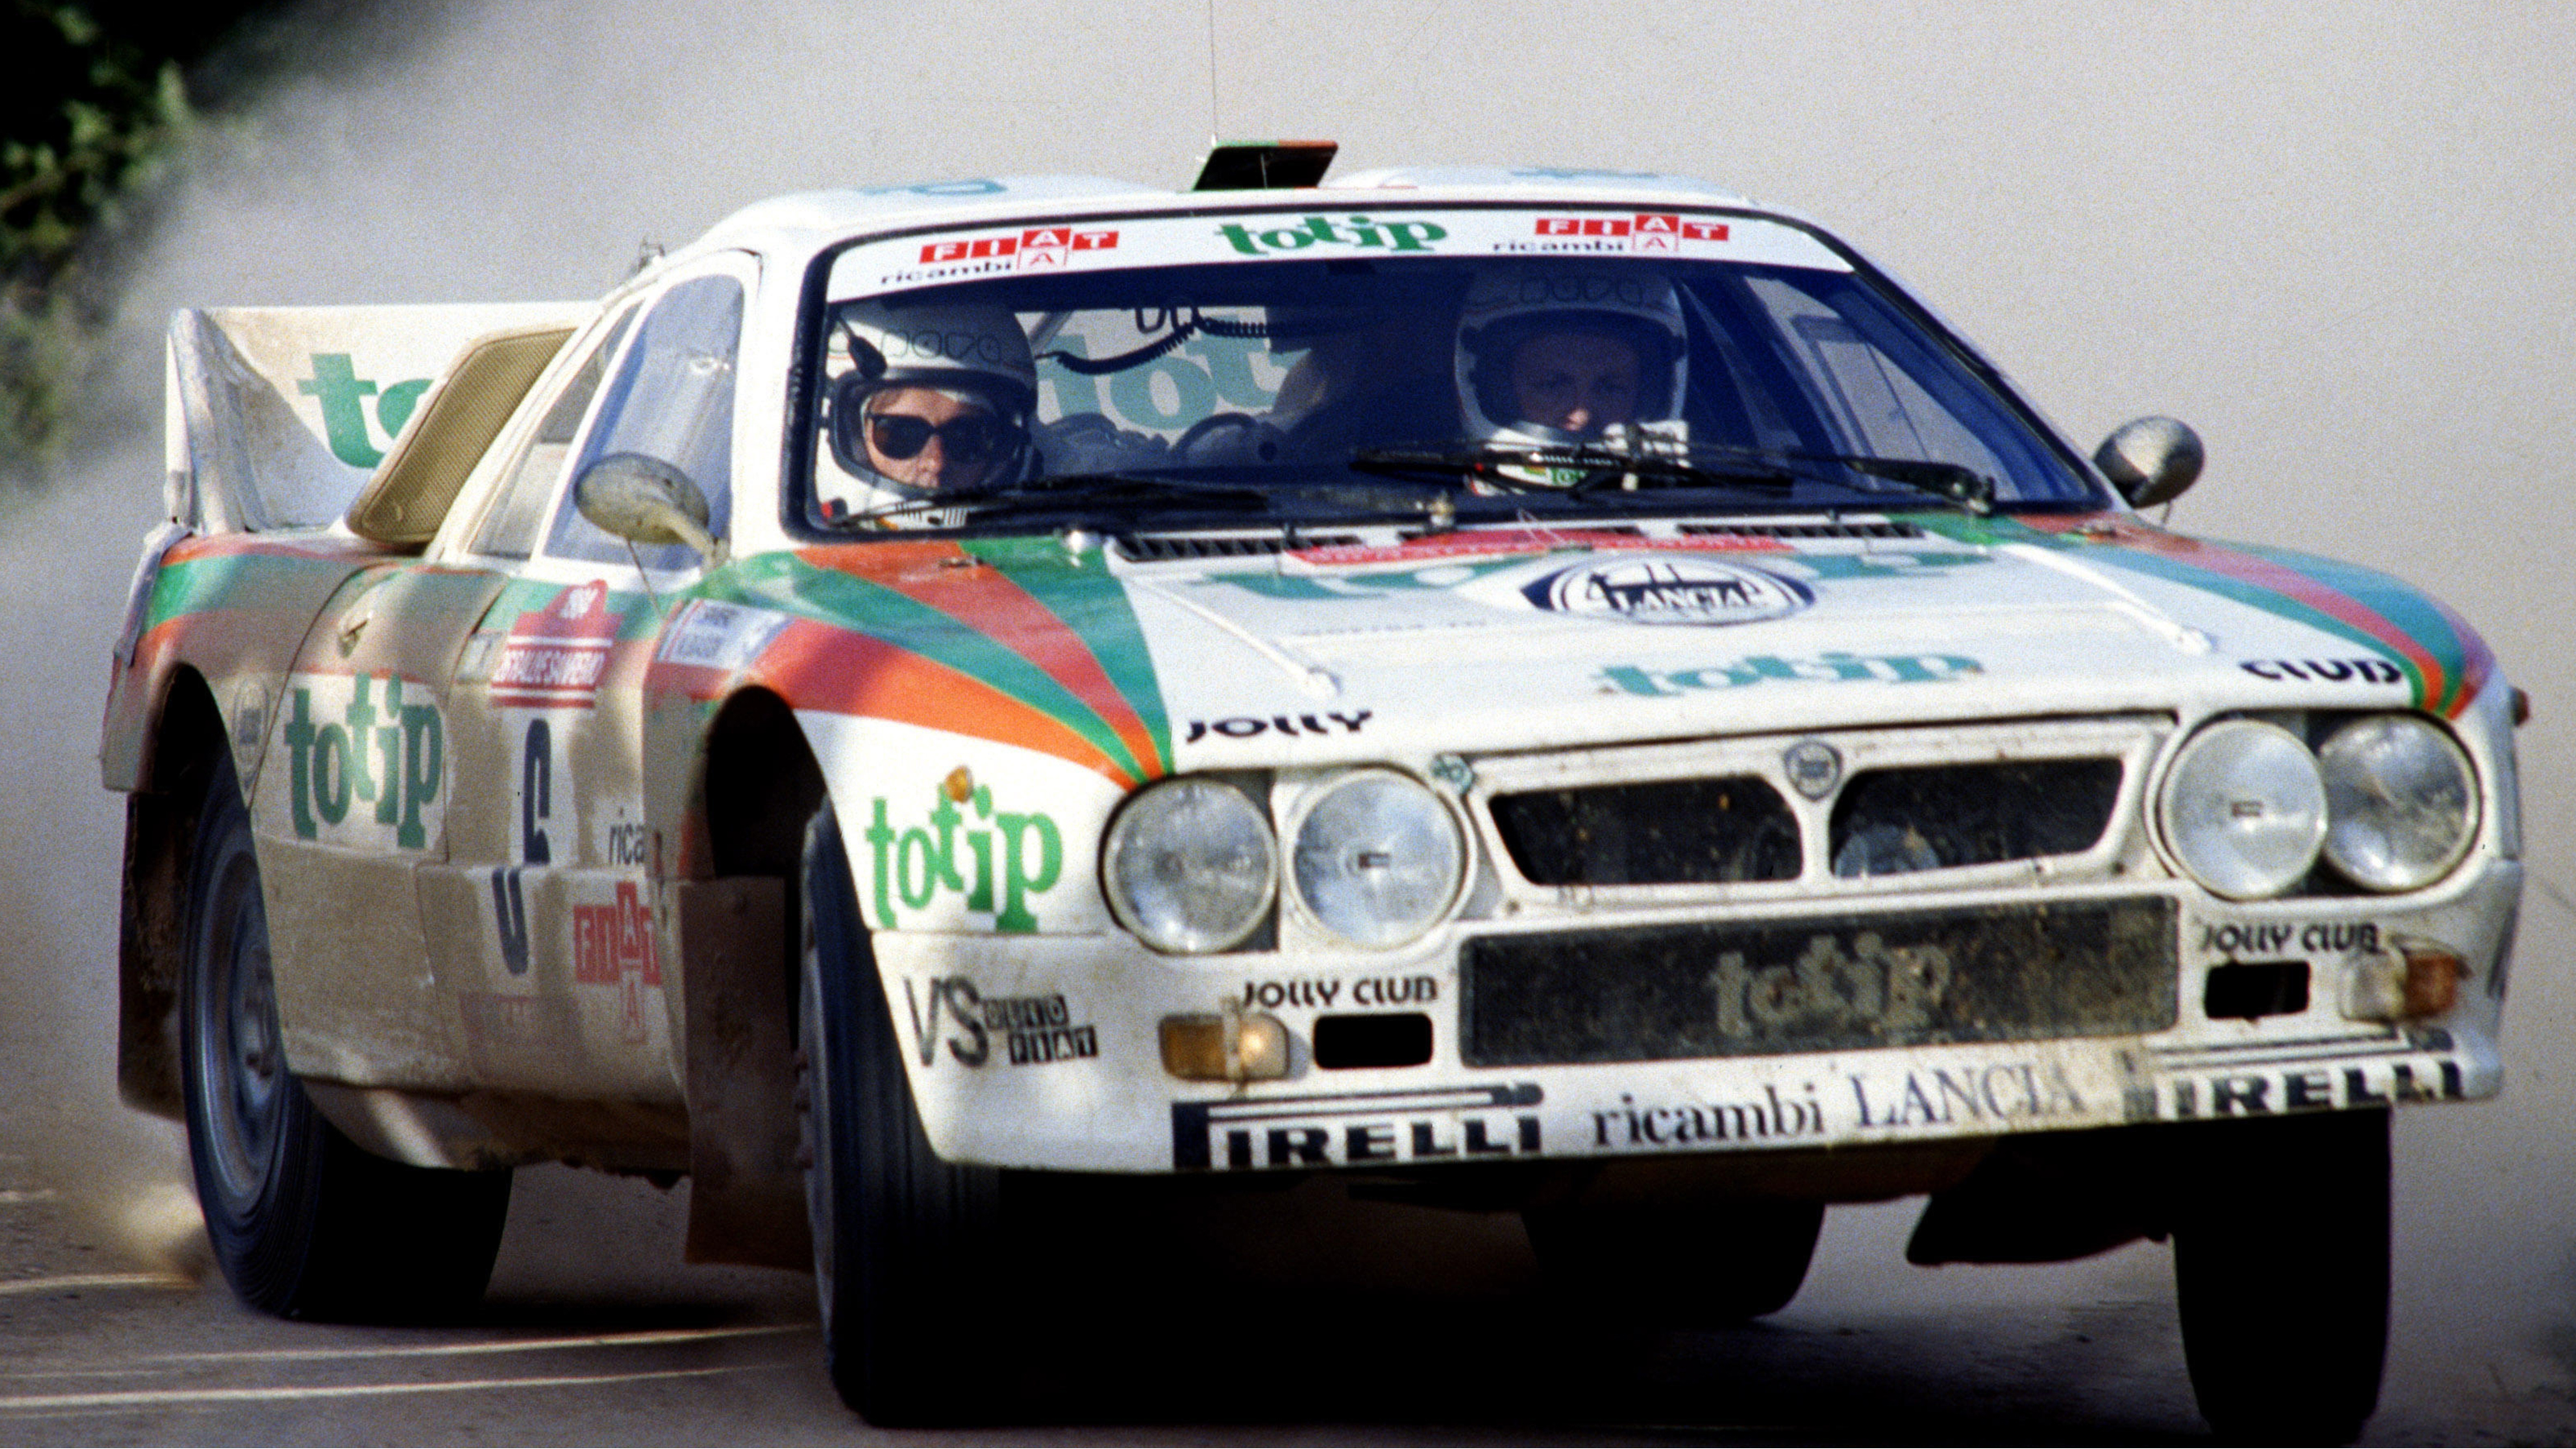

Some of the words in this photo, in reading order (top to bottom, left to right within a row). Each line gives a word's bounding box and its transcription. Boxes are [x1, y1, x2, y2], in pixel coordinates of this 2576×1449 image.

[919, 228, 1120, 264] FIAT
[1214, 216, 1447, 255] totip
[1492, 241, 1624, 252] ricambi
[1534, 214, 1729, 242] FIAT
[880, 260, 1012, 284] ricambi
[1590, 652, 1985, 696] totip
[2240, 658, 2402, 684] CLUB
[1186, 709, 1373, 744] JOLLY
[284, 672, 442, 849] totip
[865, 775, 1063, 933] totip
[2201, 923, 2292, 952] JOLLY
[2301, 923, 2381, 954] CLUB
[1243, 980, 1340, 1007] JOLLY
[1353, 976, 1438, 1005] CLUB
[902, 975, 990, 1068] VS
[1009, 1025, 1099, 1065] FIAT
[2116, 1025, 2463, 1124] PIRELLI
[1171, 1084, 1544, 1172] PIRELLI
[1592, 1082, 1826, 1148] ricambi
[1848, 1063, 2095, 1128] LANCIA
